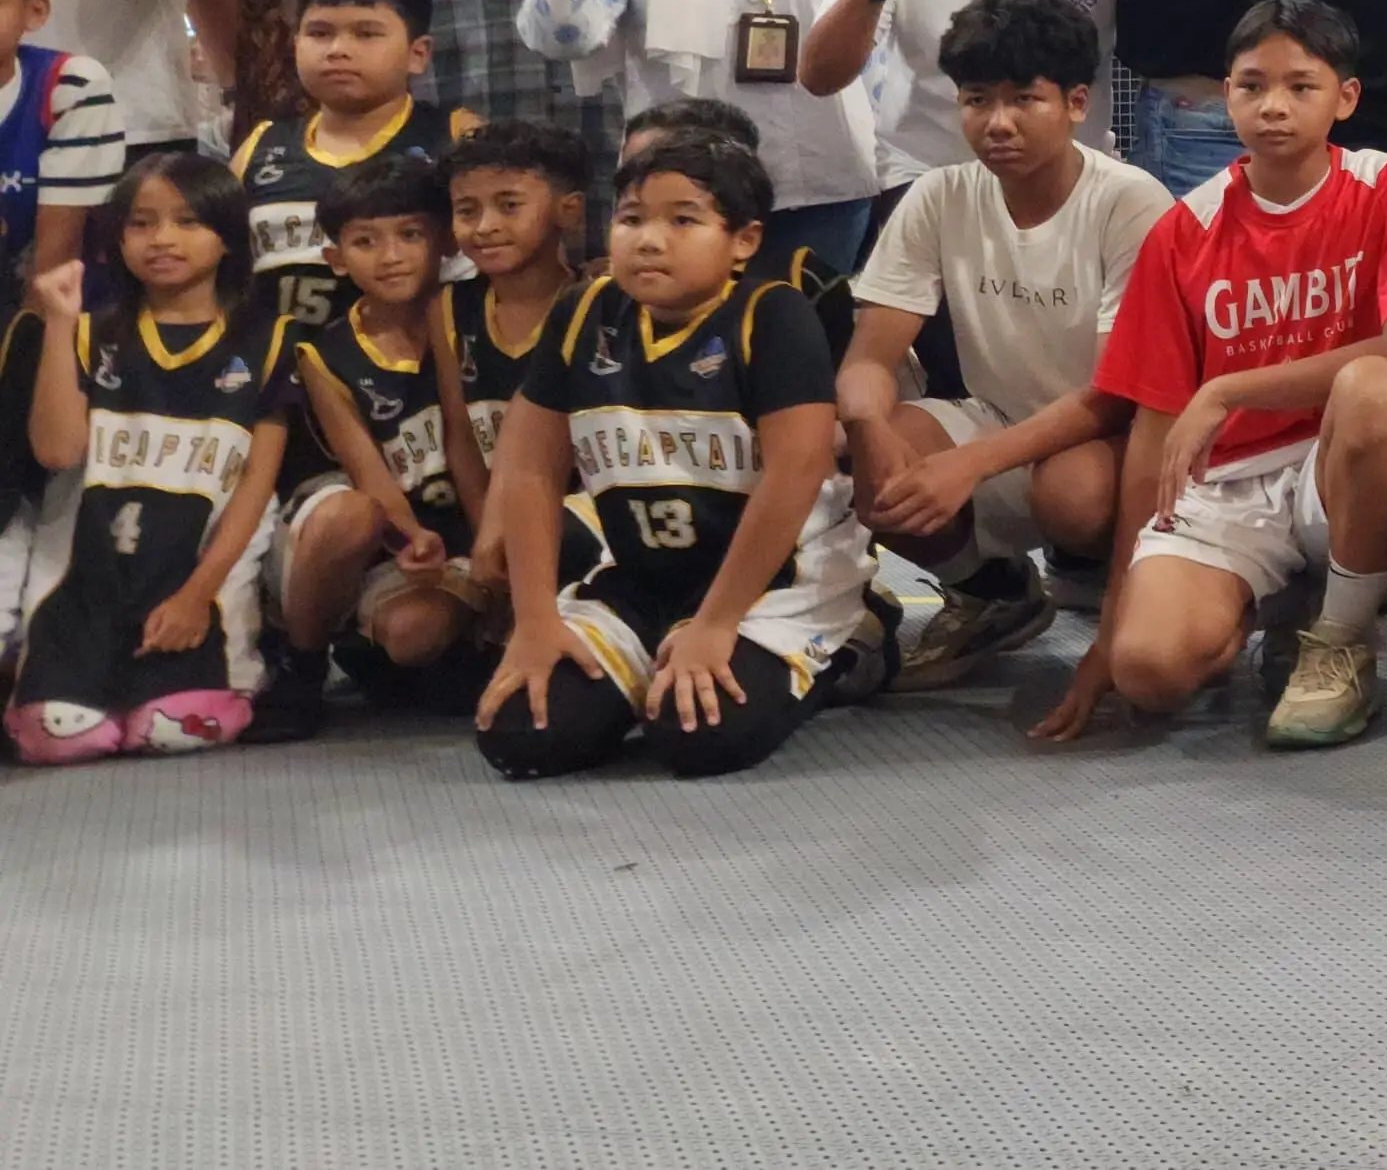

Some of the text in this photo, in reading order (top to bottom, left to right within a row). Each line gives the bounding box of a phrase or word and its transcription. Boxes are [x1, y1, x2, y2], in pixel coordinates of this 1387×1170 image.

[279, 276, 337, 324] 15
[1205, 251, 1364, 339] GAMBIT
[628, 498, 698, 549] 13
